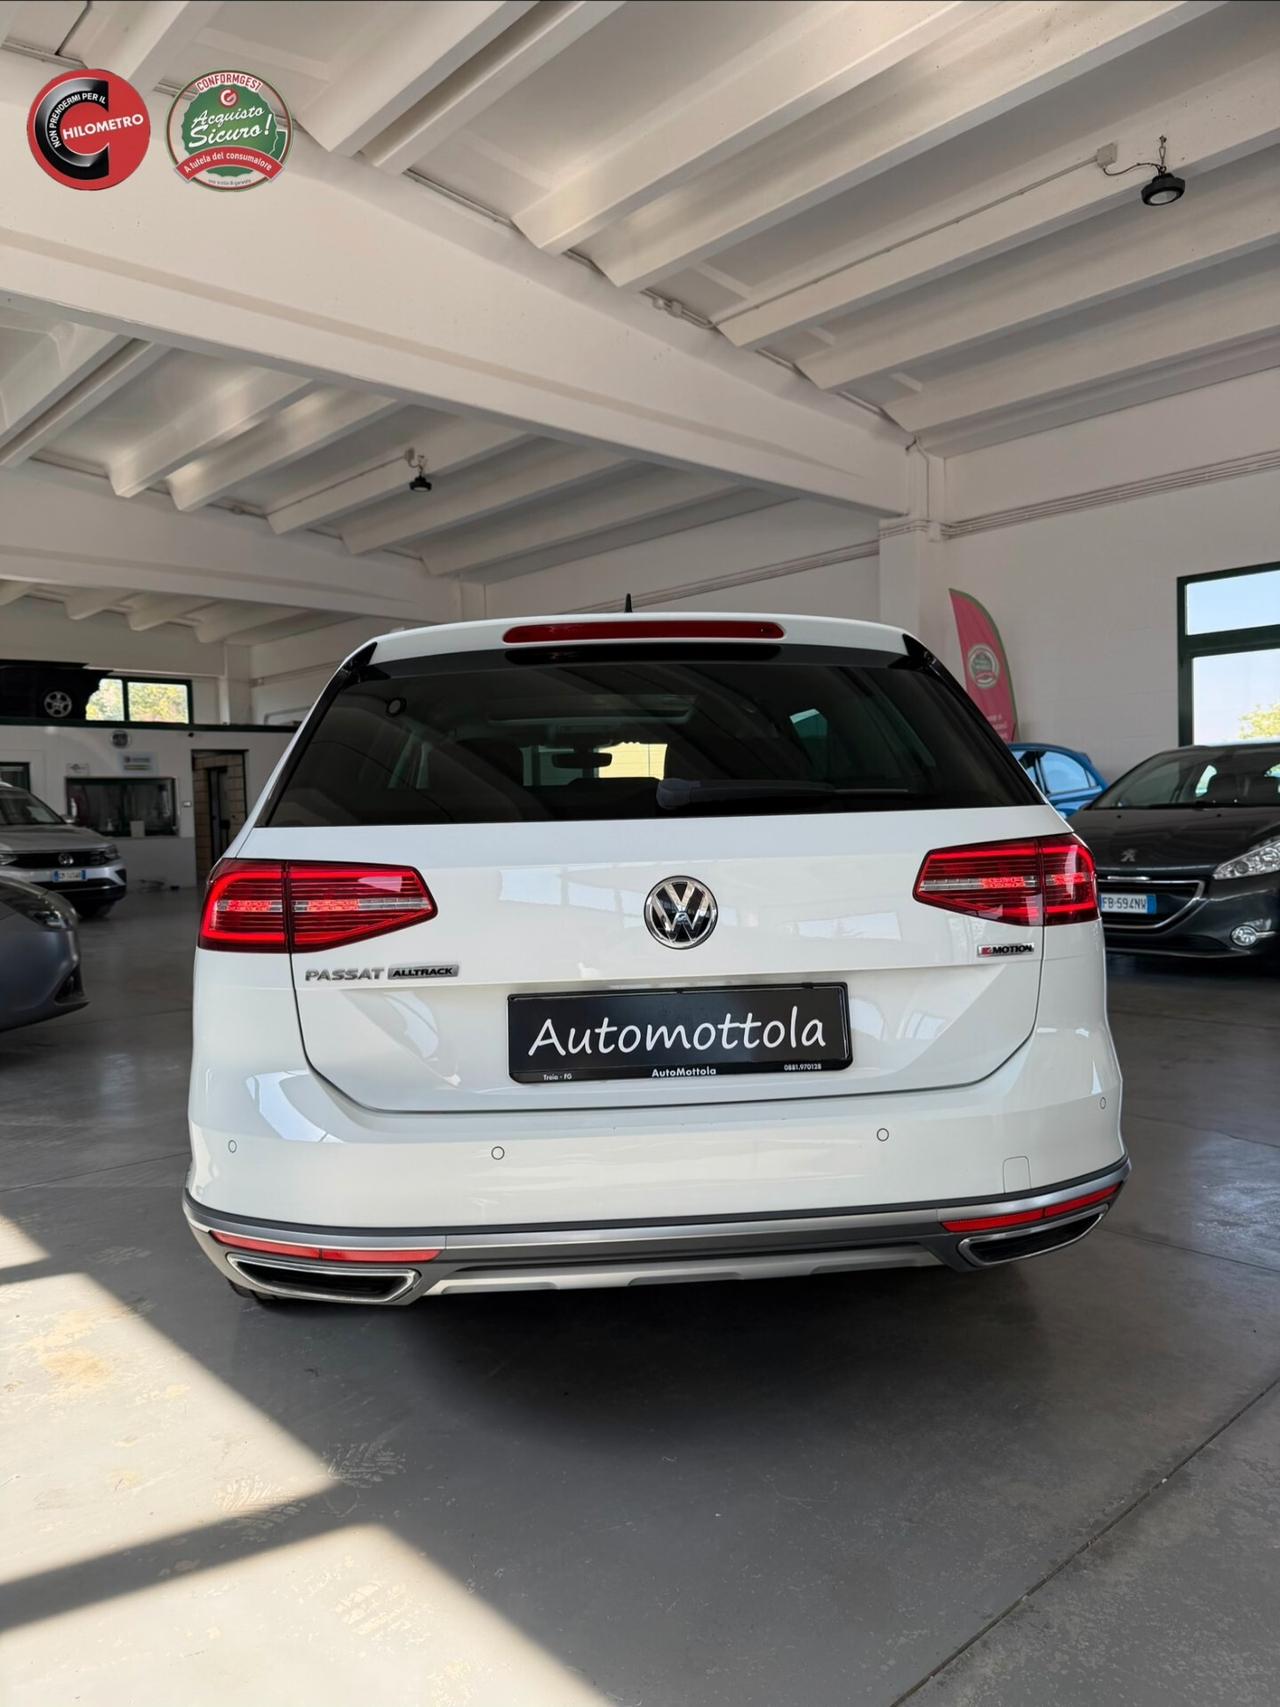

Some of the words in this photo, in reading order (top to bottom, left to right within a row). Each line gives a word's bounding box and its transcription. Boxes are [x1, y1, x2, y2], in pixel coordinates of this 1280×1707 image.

[305, 967, 384, 982] PASSAT
[392, 966, 453, 978] ALLTRACK
[528, 1005, 827, 1057] Automottola
[651, 1066, 717, 1078] AutoMottola
